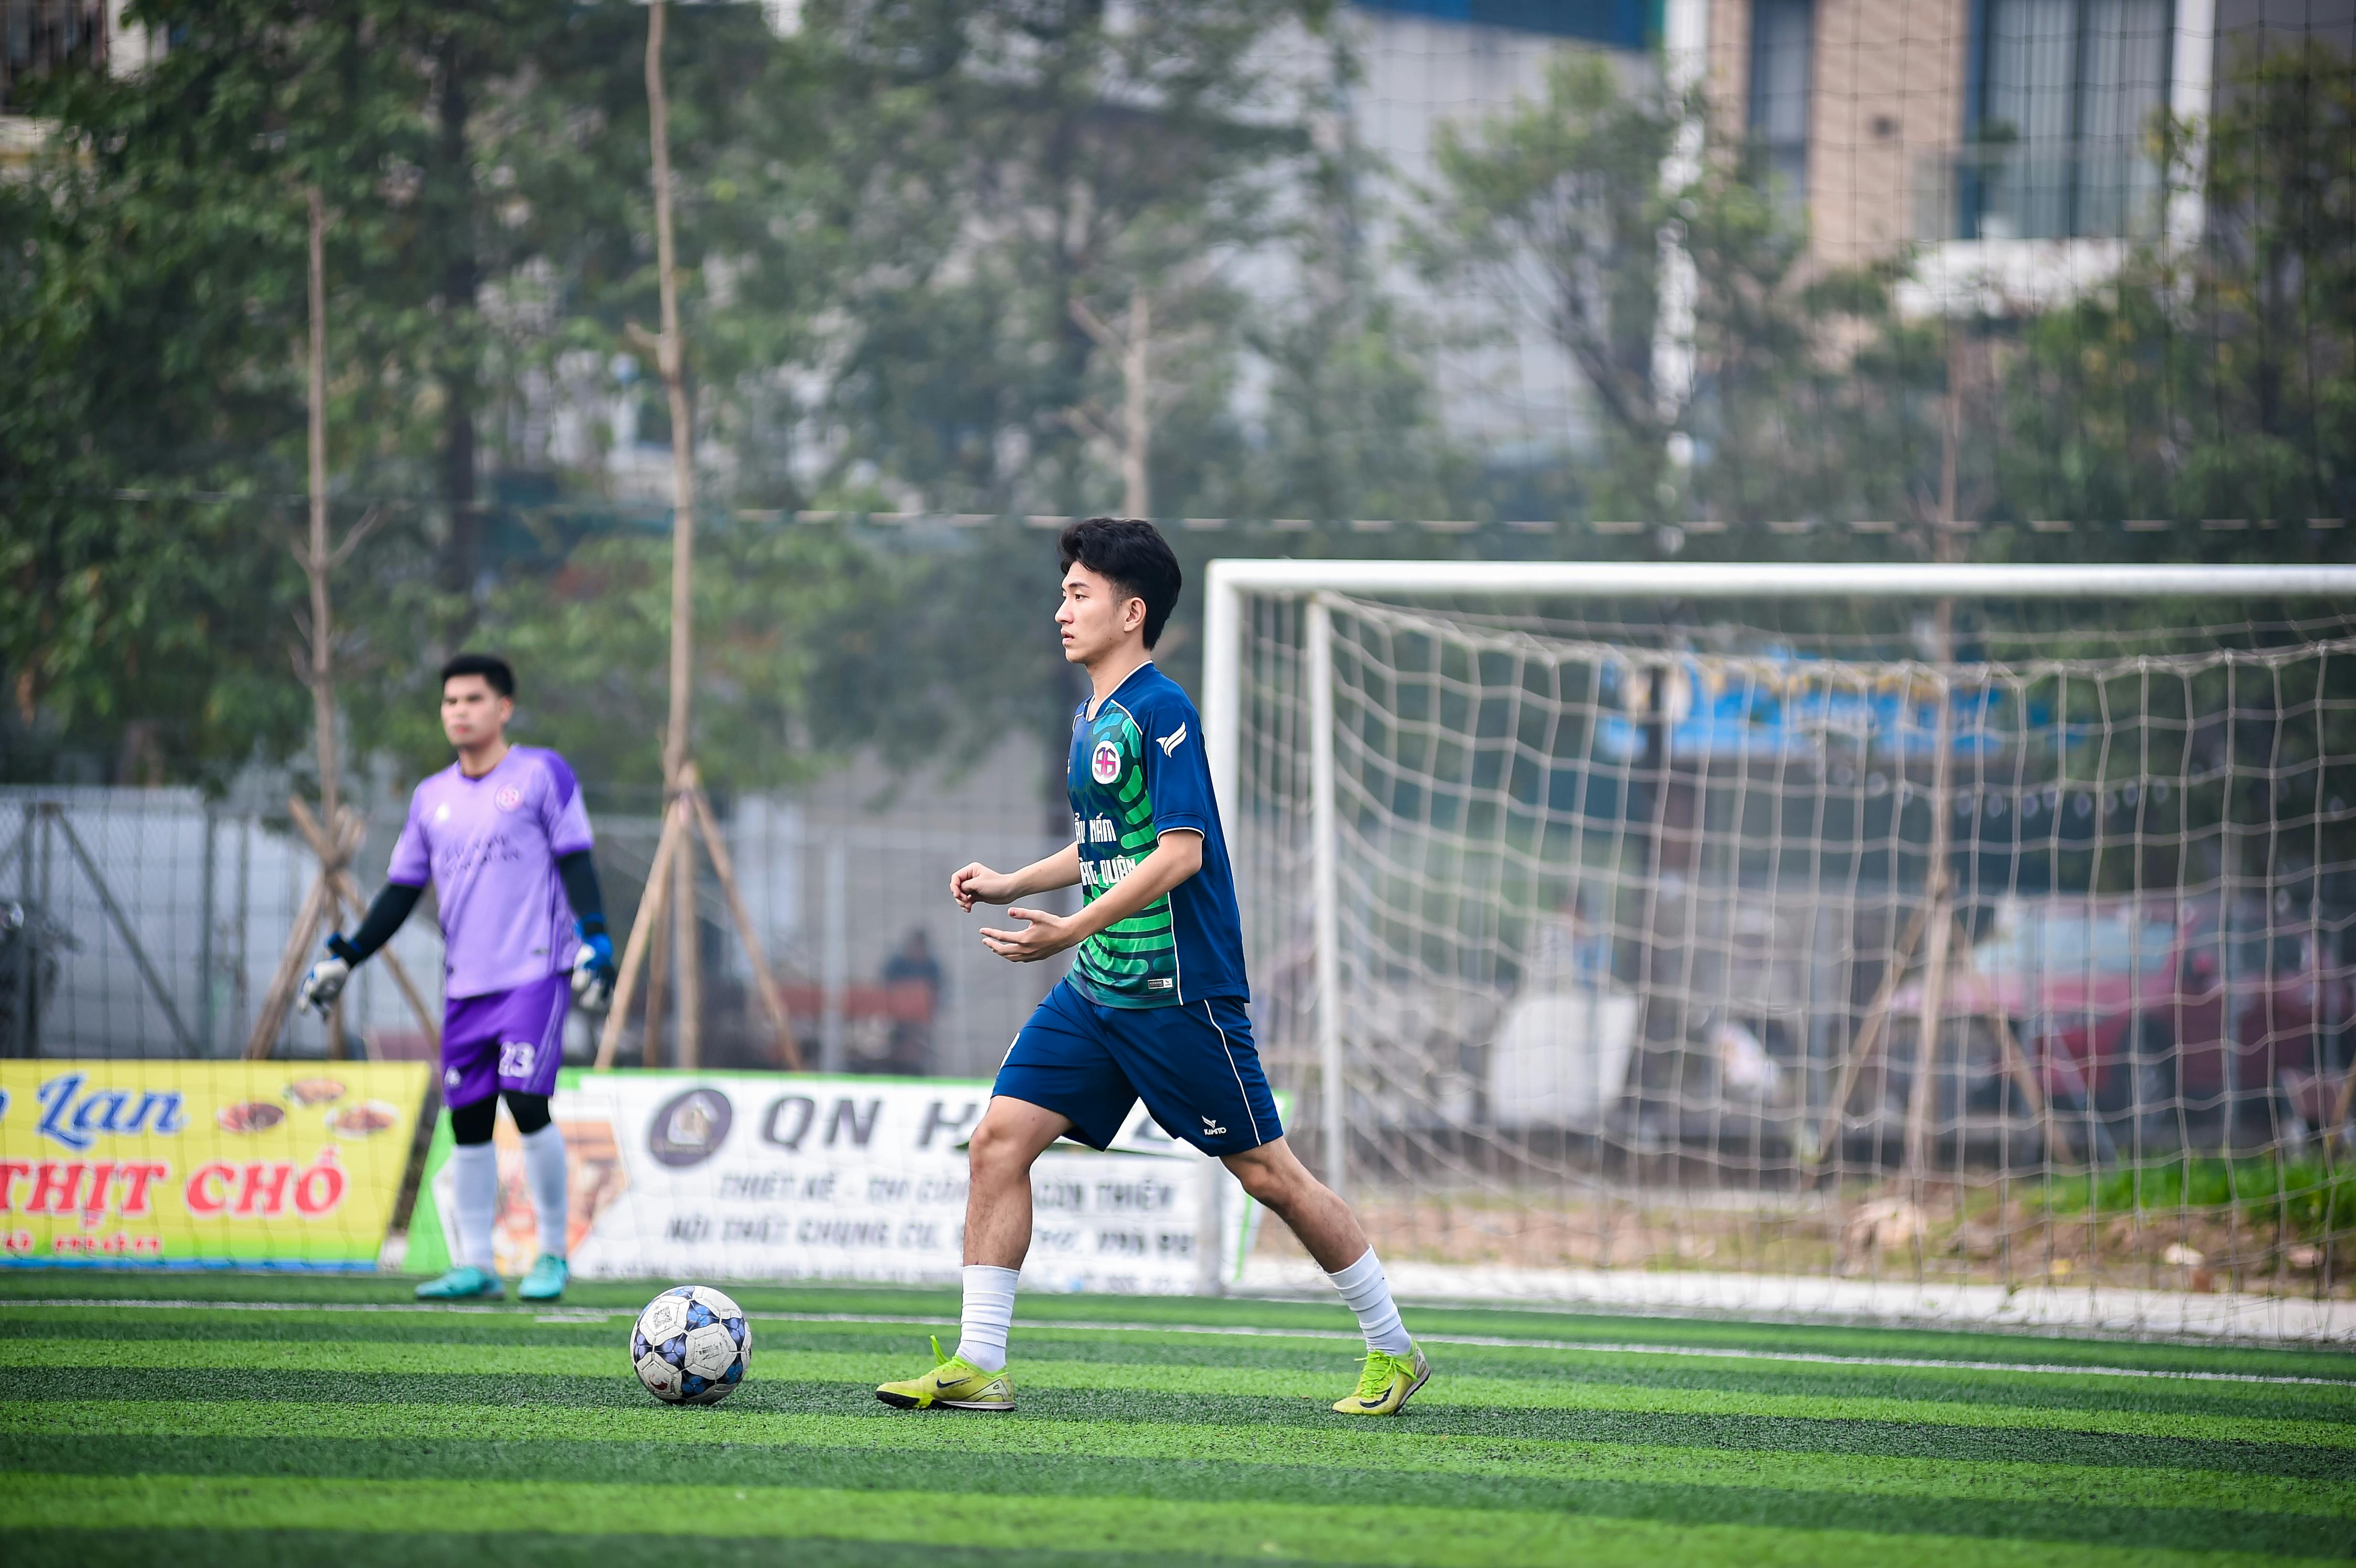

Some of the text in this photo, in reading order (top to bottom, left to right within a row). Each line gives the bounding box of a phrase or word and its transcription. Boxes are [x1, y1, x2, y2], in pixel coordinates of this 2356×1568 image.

[1089, 812, 1117, 843] NẤM
[36, 1073, 185, 1149] Lan
[764, 1096, 883, 1149] QN
